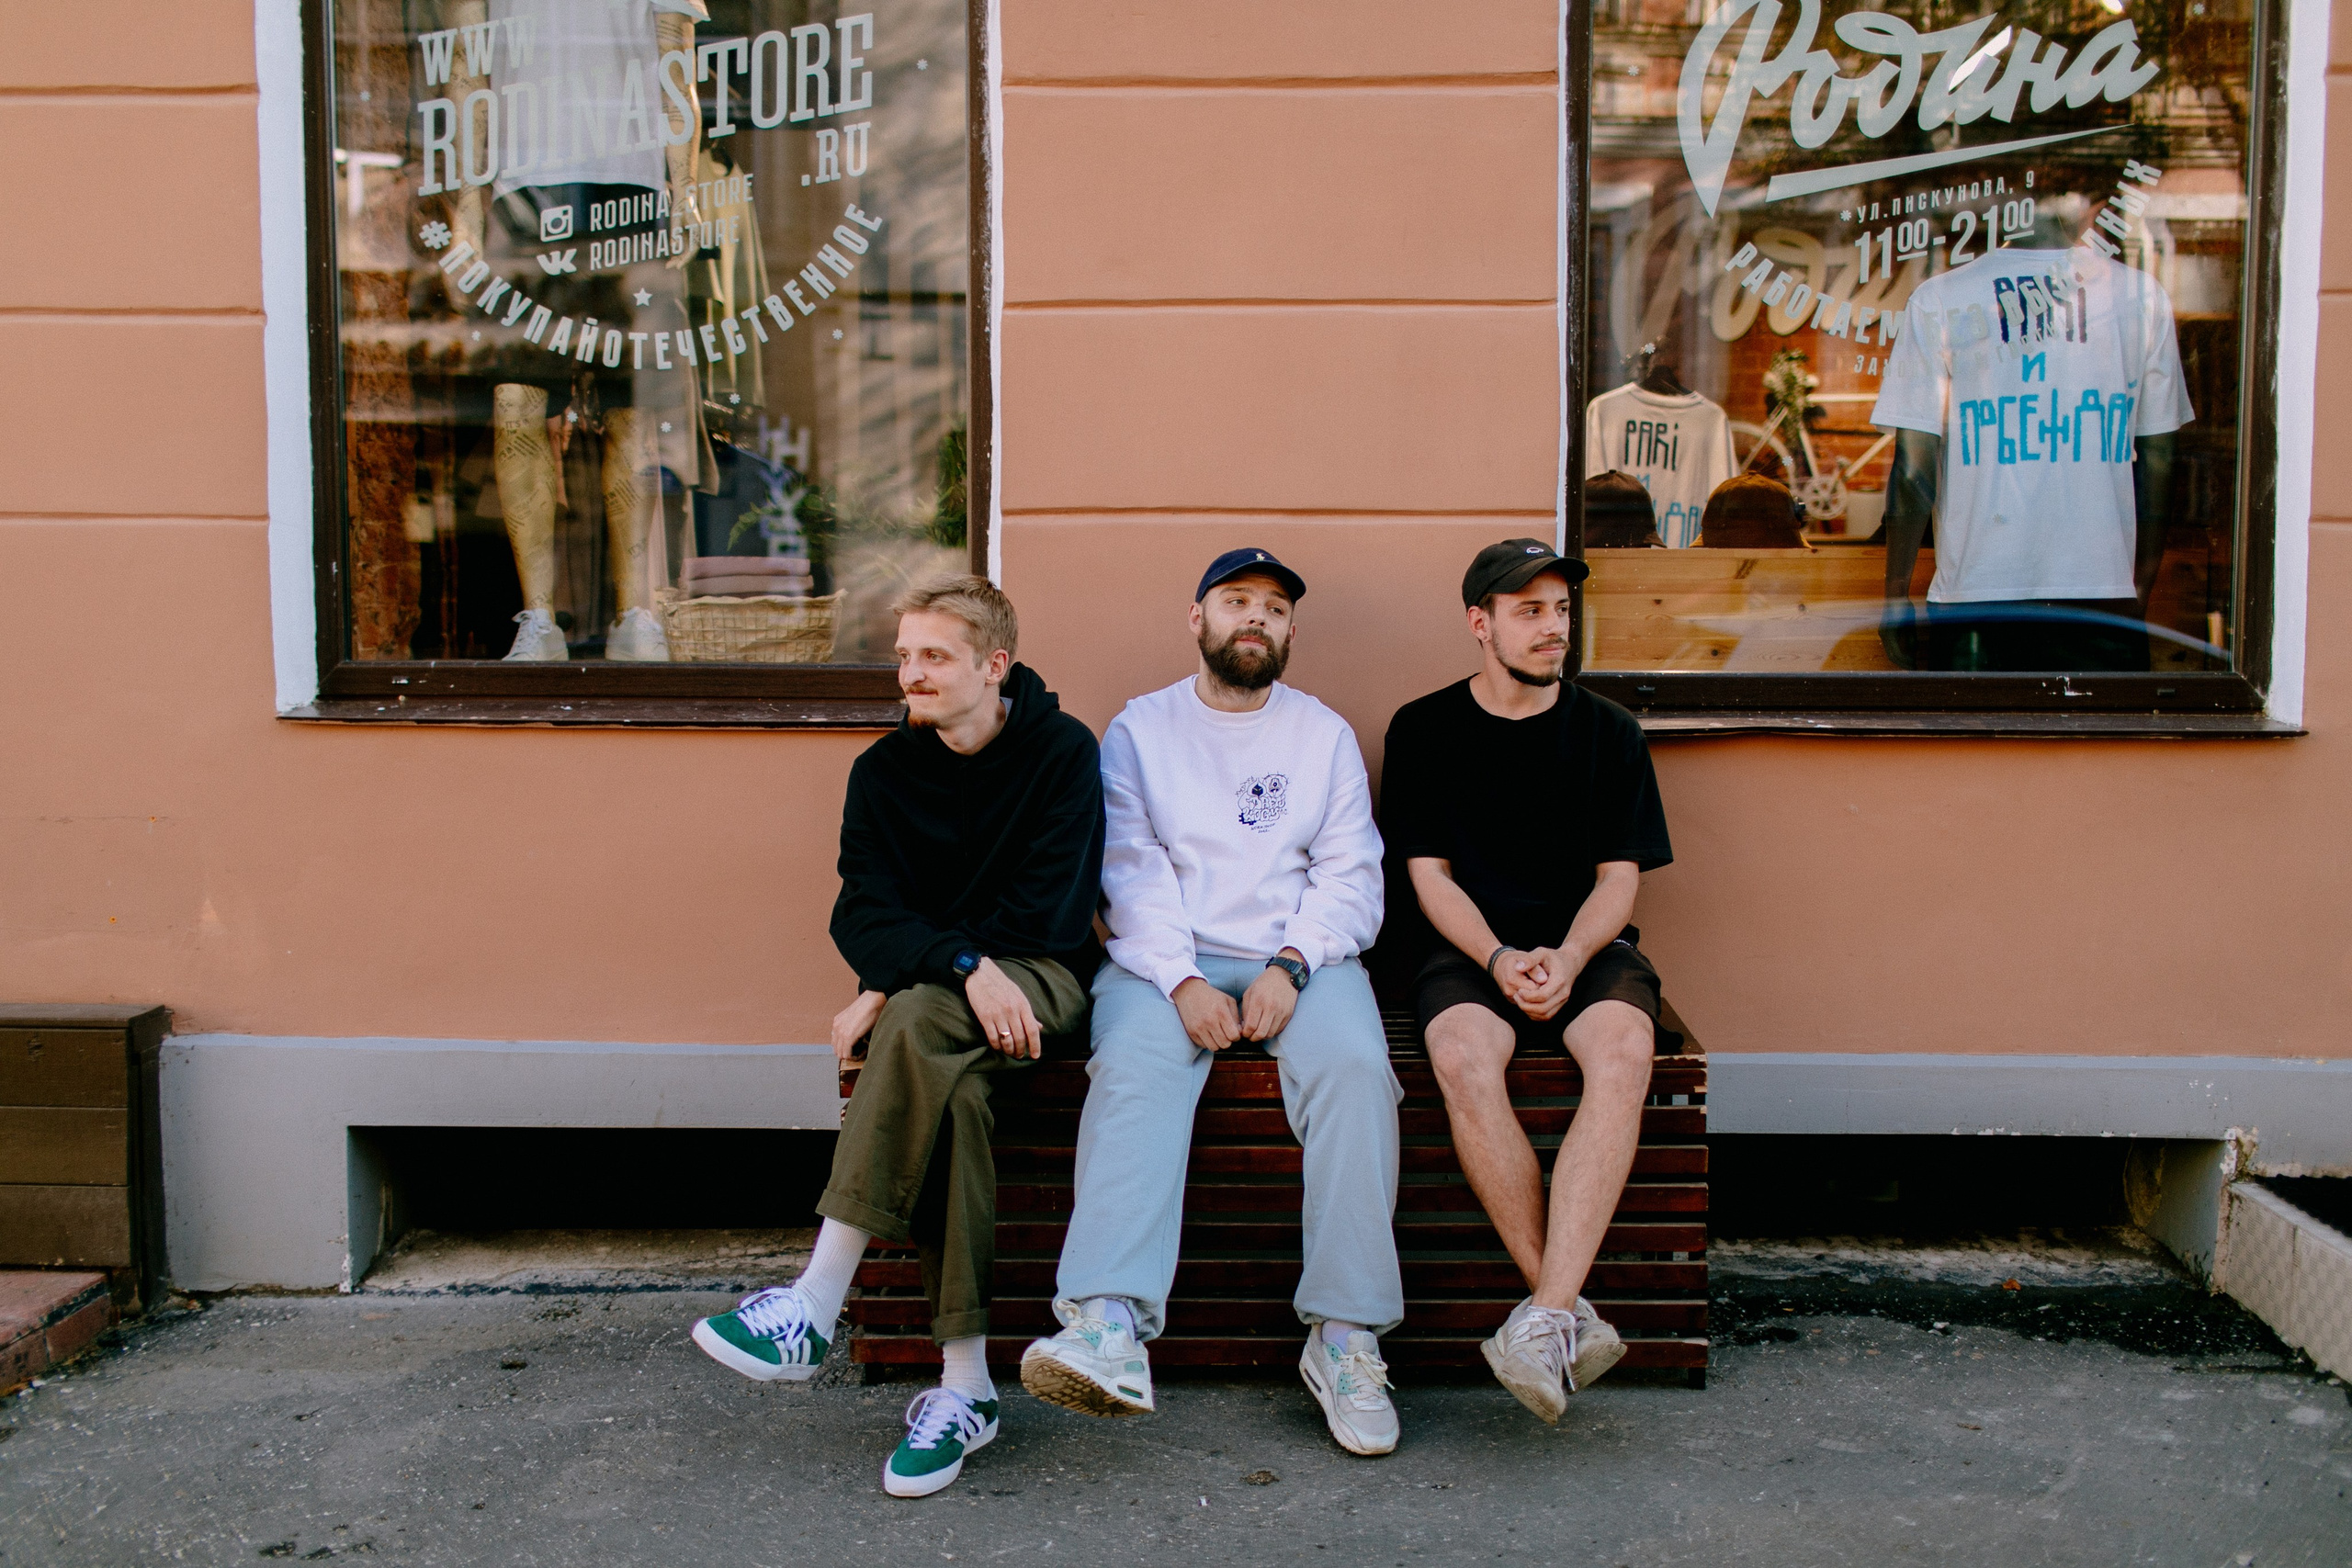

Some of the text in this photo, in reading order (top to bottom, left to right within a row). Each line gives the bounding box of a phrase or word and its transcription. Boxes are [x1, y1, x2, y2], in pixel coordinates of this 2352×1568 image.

[418, 13, 874, 196] RODINASTORE
[801, 121, 871, 186] .RU
[2026, 170, 2035, 188] 9
[591, 216, 740, 271] RODINASTORE
[1724, 242, 1905, 346] РАБОТАЕМ
